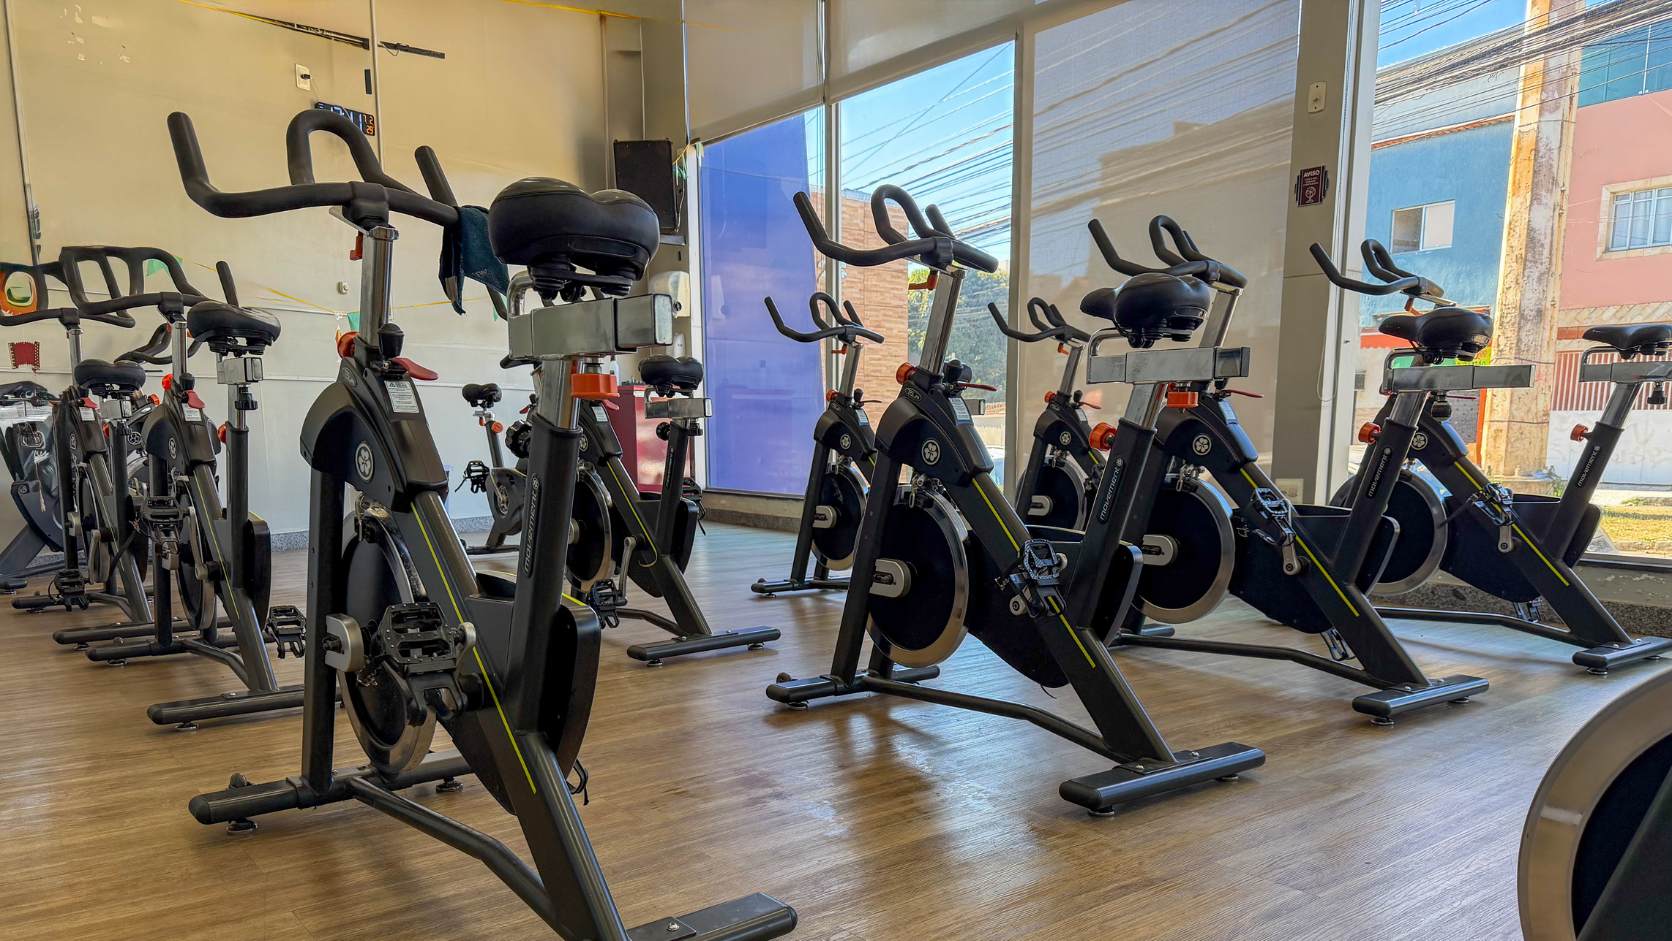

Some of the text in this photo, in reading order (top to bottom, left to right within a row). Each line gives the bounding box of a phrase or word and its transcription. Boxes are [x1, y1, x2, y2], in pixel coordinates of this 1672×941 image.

[1303, 169, 1320, 178] AVISO
[1368, 454, 1388, 497] movement
[1577, 451, 1598, 487] movement
[1100, 467, 1121, 521] movement
[524, 490, 539, 573] movement
